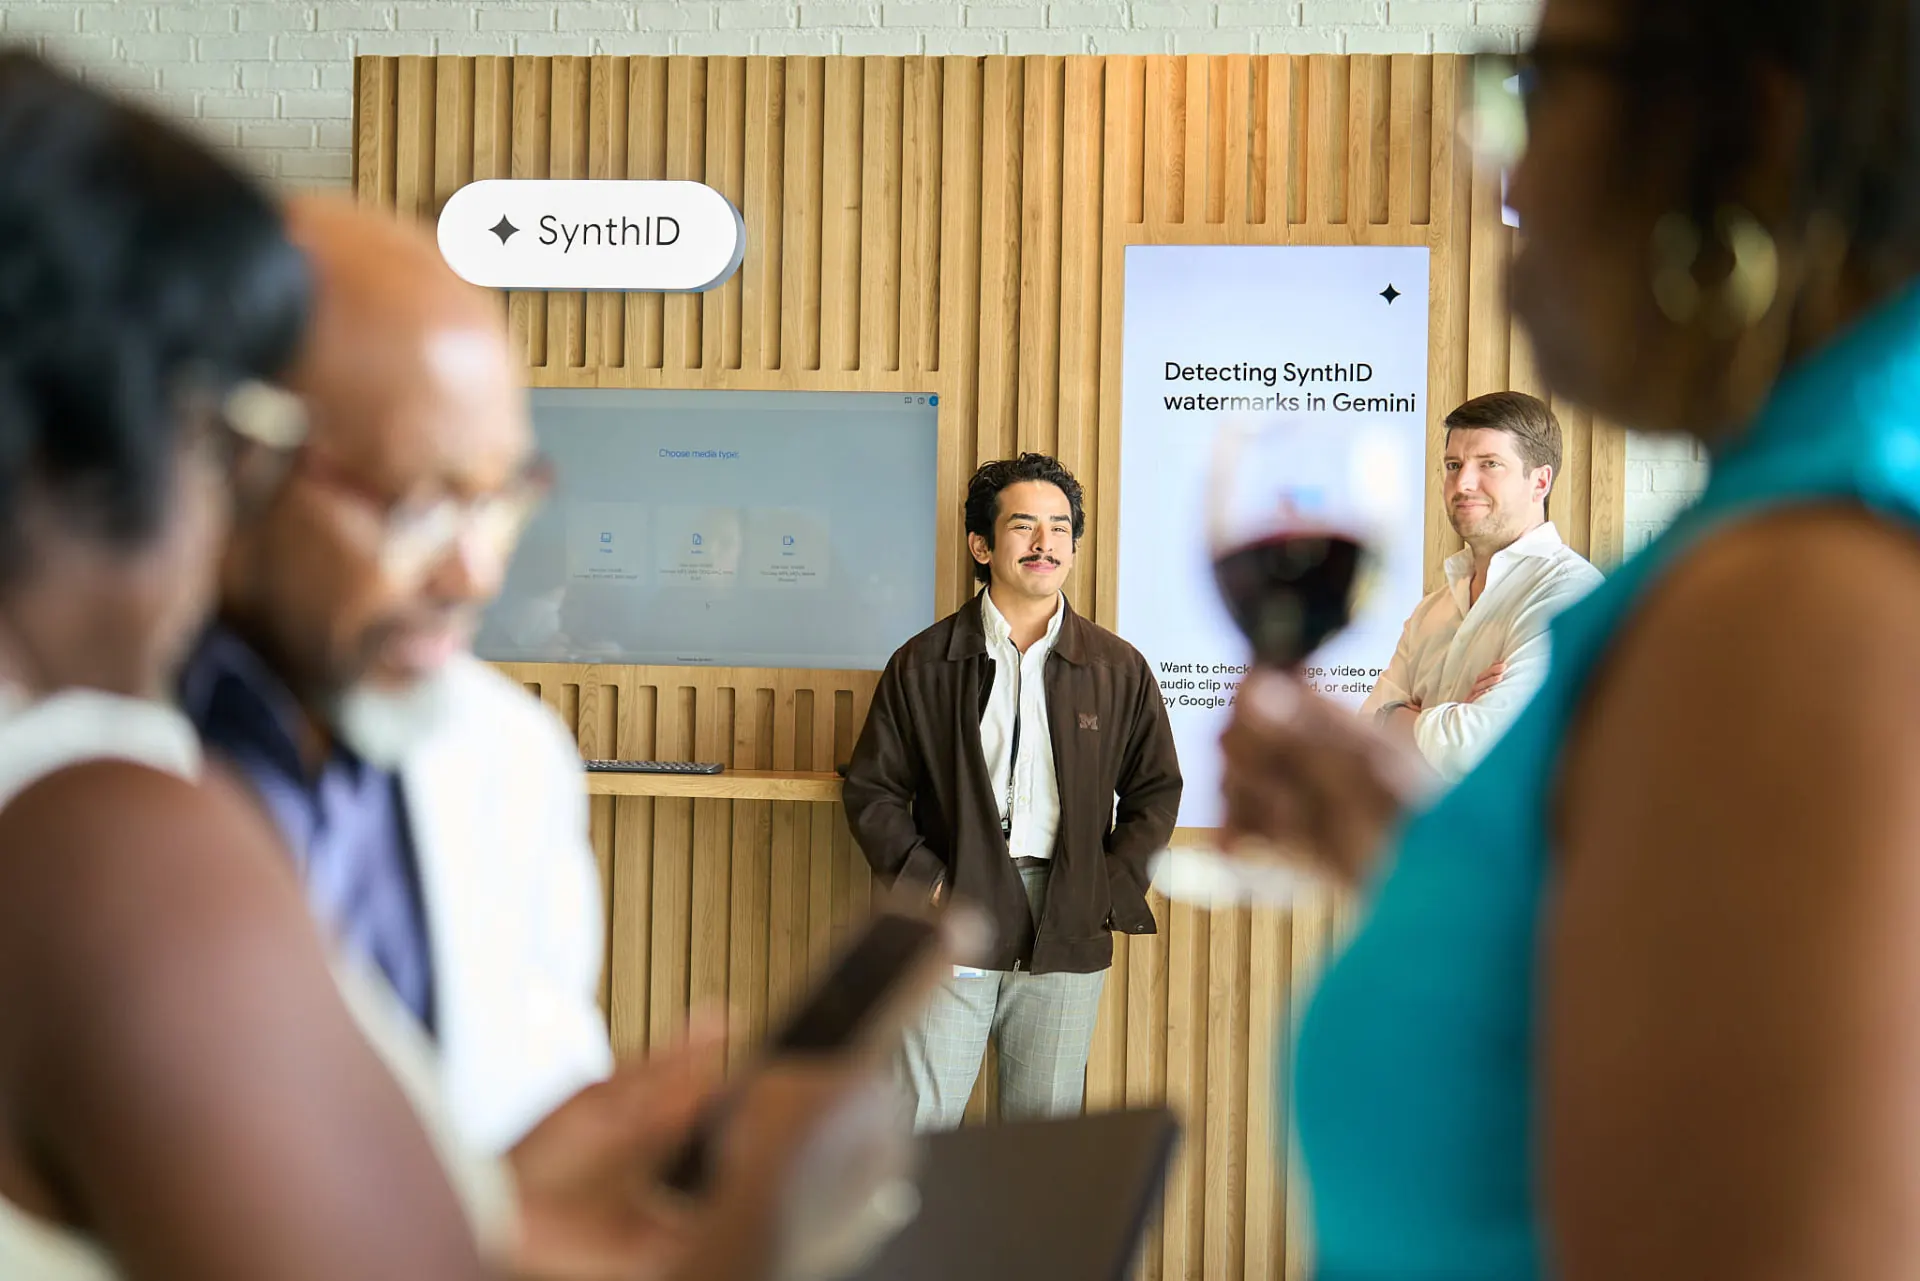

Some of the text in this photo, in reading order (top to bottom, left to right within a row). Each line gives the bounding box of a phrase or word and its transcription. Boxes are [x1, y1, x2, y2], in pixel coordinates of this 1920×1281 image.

[538, 214, 681, 254] SynthID
[1164, 361, 1373, 387] Detecting SynthID
[1164, 393, 1416, 413] watermarks in Gemini
[658, 448, 691, 458] Choose
[692, 449, 718, 458] media
[1160, 661, 1193, 674] Want
[1196, 663, 1209, 674] to
[1212, 663, 1251, 675] check
[1330, 665, 1366, 677] video
[1369, 668, 1383, 677] or
[1160, 679, 1195, 690] audio
[1198, 679, 1221, 693] clip
[1324, 683, 1338, 693] or
[1341, 682, 1374, 693] edite
[1179, 694, 1226, 709] Google
